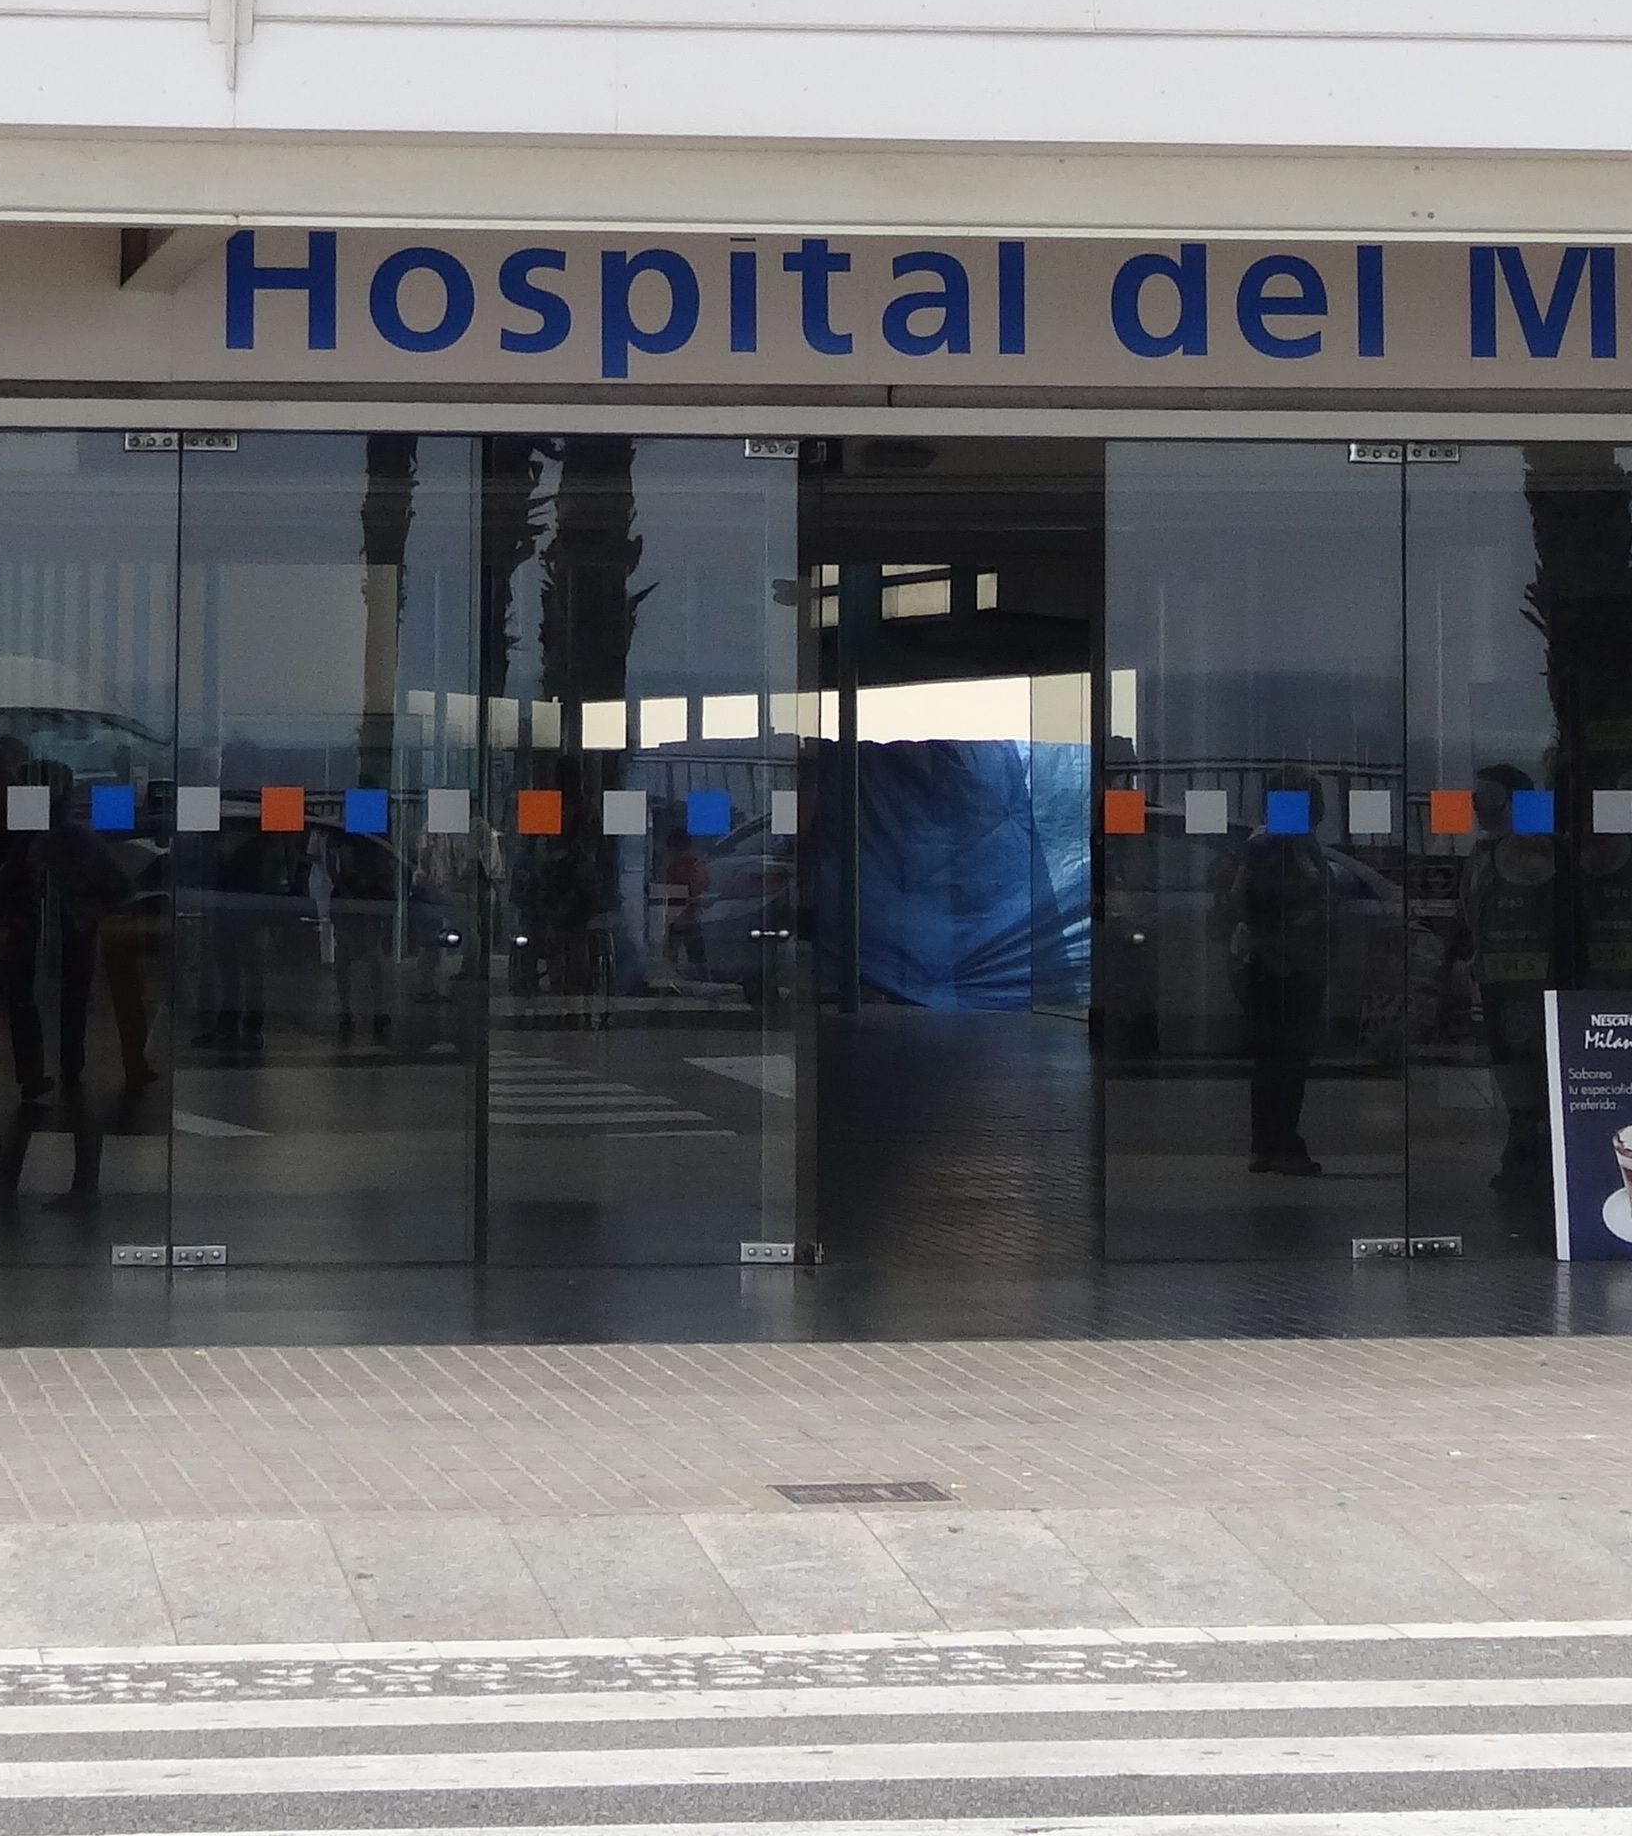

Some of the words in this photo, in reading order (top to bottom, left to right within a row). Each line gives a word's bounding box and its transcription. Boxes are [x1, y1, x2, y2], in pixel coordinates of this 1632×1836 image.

[225, 228, 1026, 379] Hospital
[1110, 243, 1385, 359] del
[1568, 1067, 1613, 1080] Saborea
